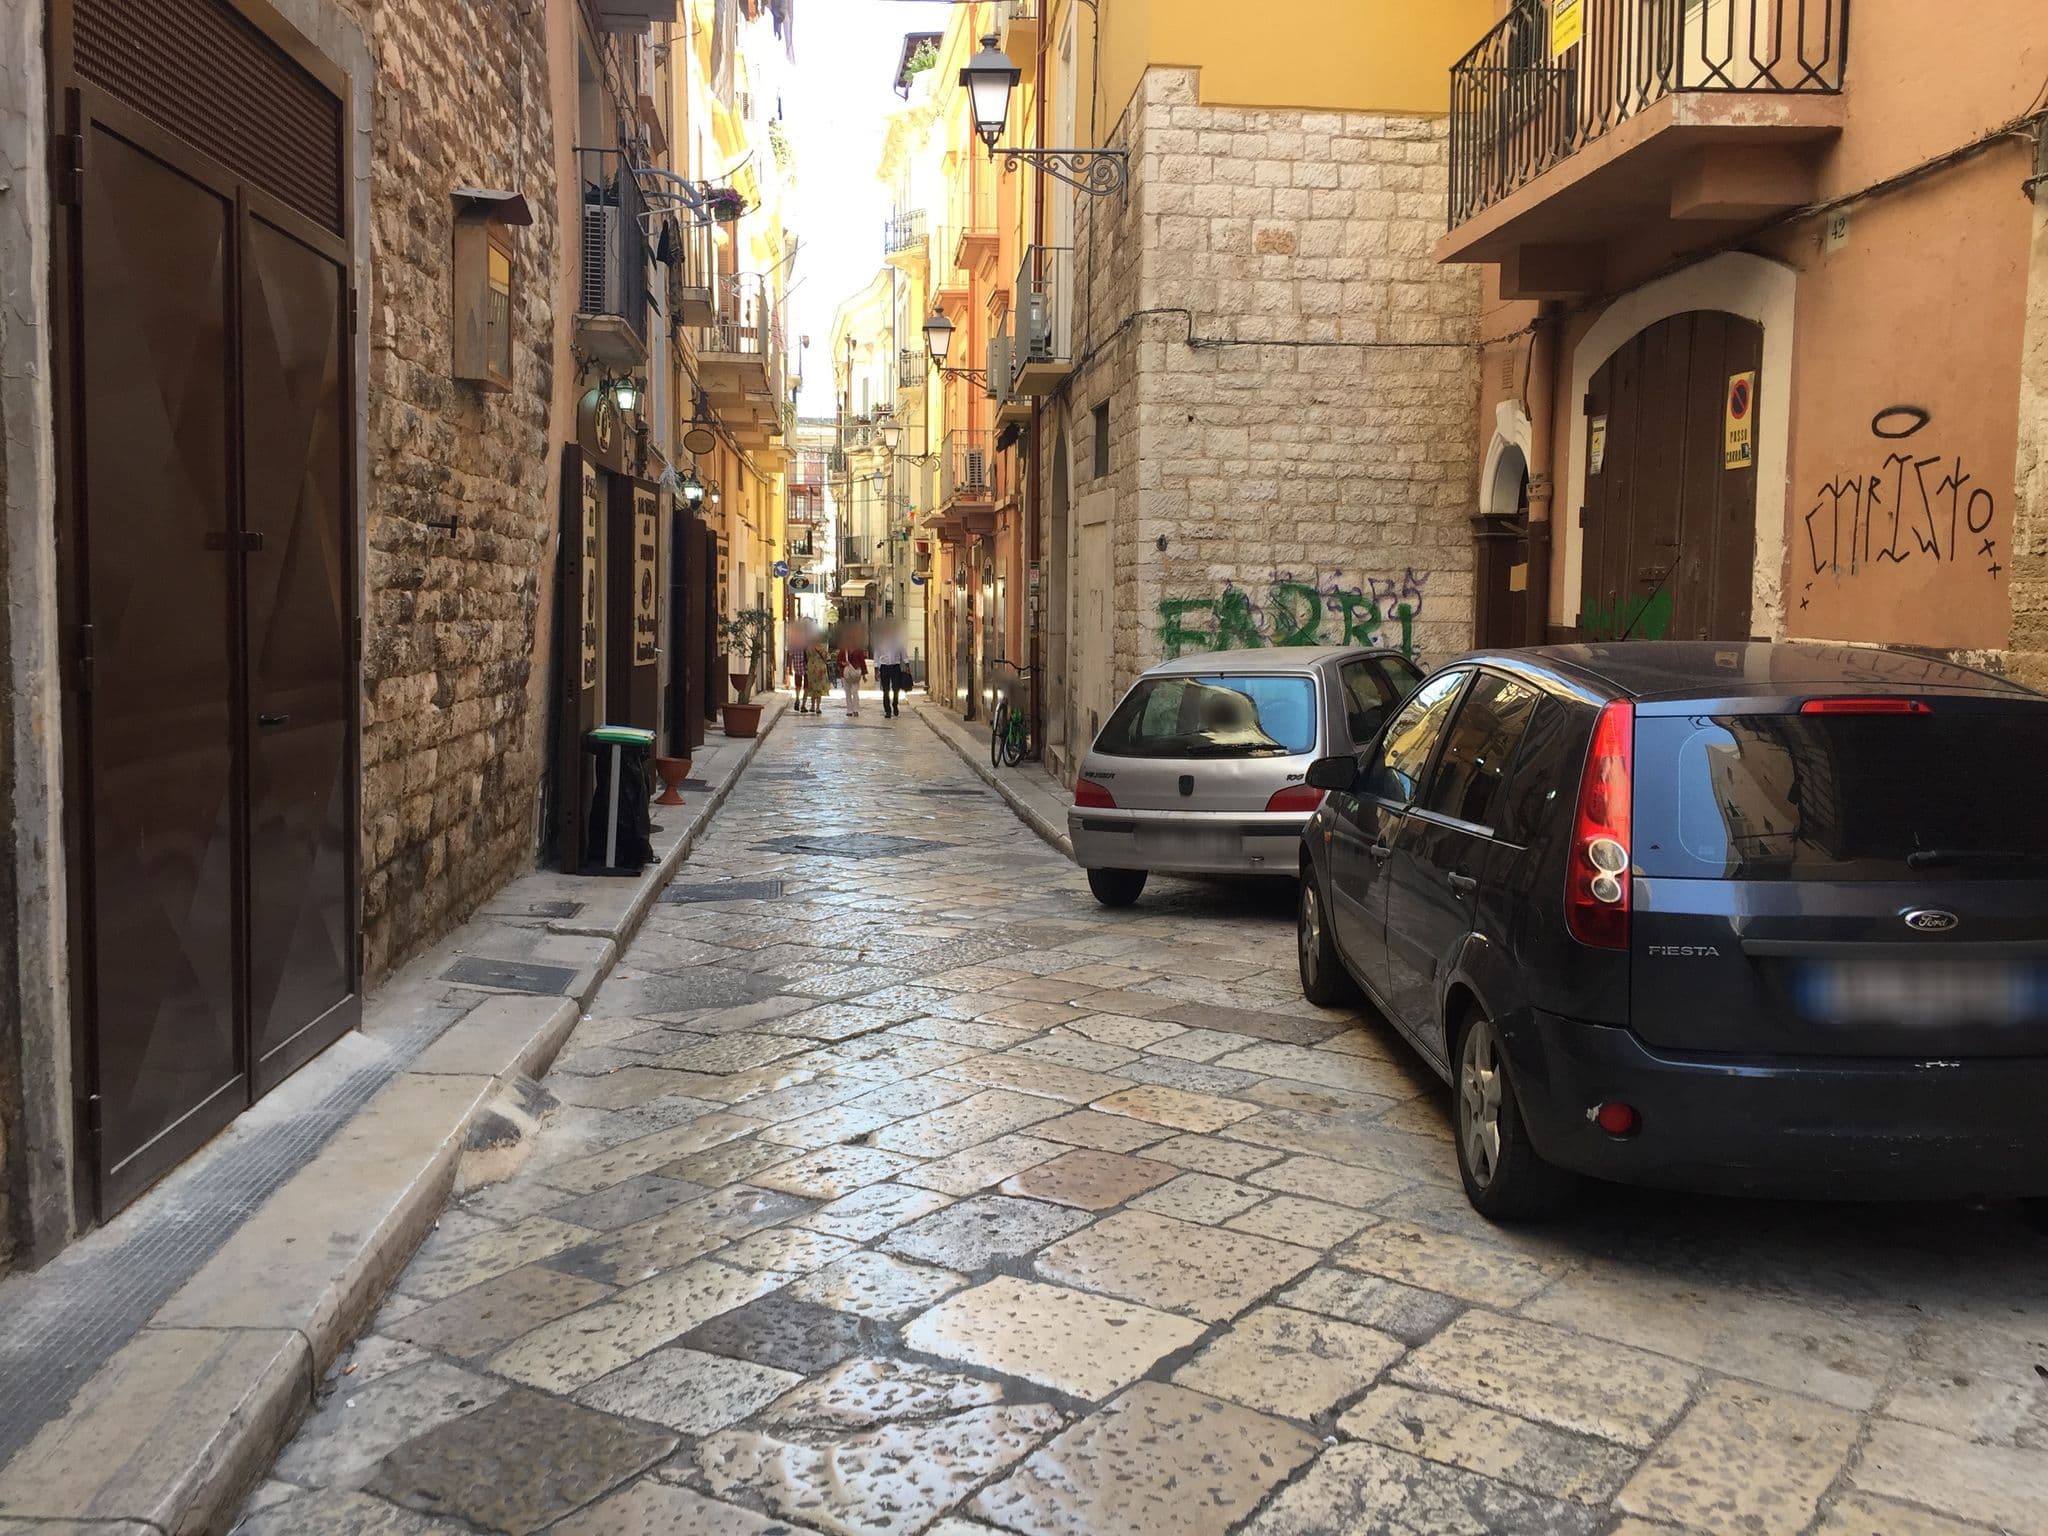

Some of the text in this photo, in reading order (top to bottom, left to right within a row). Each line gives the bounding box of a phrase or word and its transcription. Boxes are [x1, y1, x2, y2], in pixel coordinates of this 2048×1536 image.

[1831, 218, 1846, 240] 42
[1730, 428, 1748, 443] PASSO
[1649, 946, 1720, 957] FIESTA
